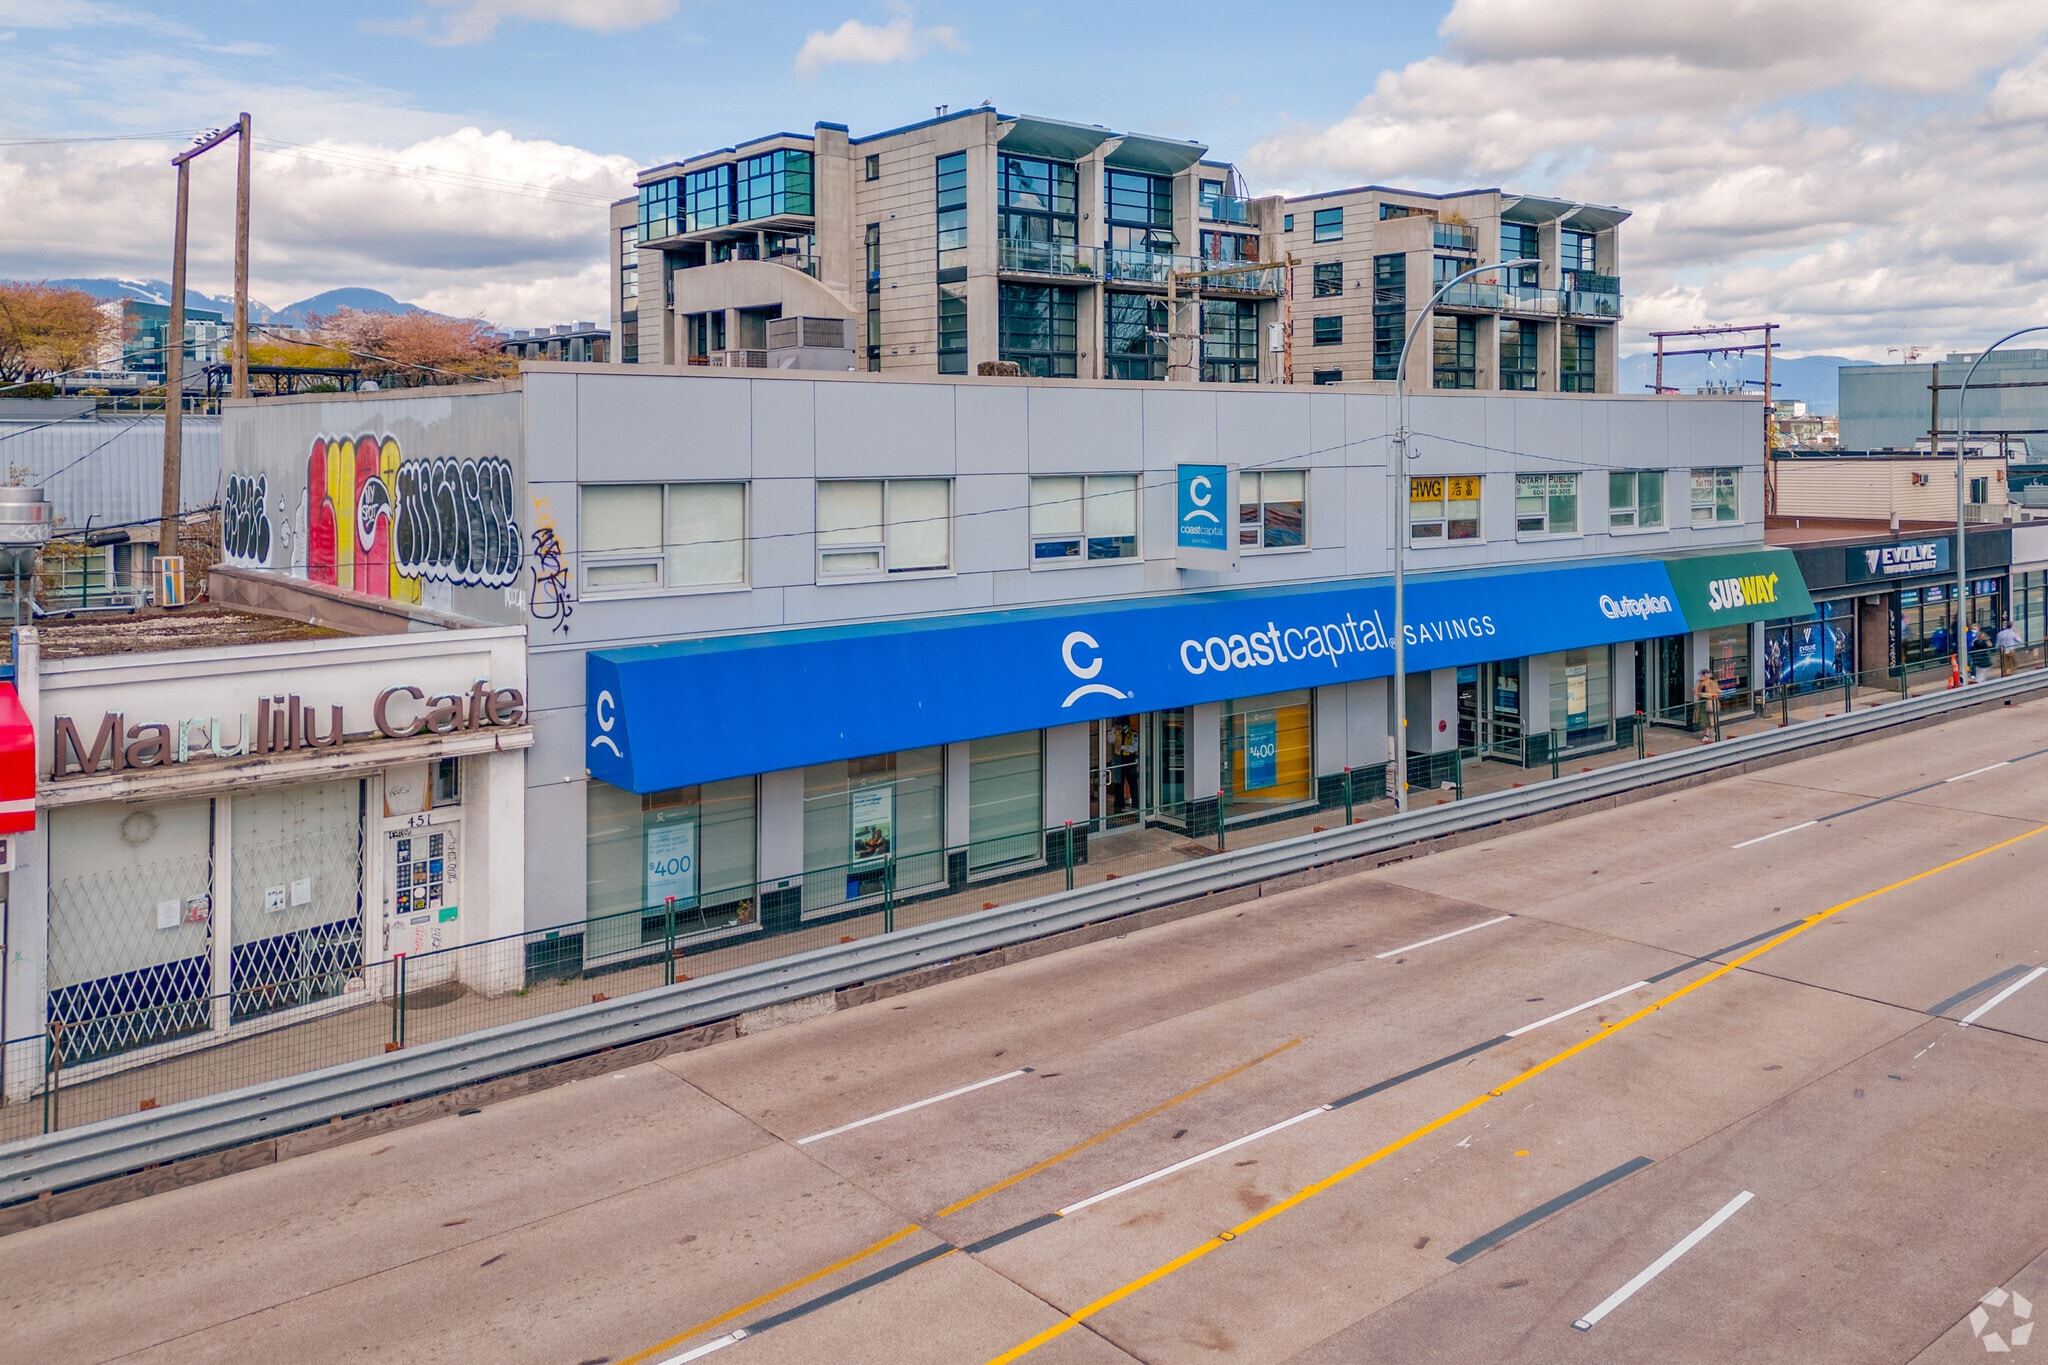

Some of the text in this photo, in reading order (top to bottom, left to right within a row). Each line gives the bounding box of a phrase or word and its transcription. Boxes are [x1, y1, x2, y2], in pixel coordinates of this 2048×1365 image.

[1411, 479, 1441, 498] HWG
[1516, 475, 1574, 484] NOTARY PUBLIC
[1882, 543, 1937, 564] EVOLVE
[1708, 572, 1779, 612] SUBWAY
[1403, 615, 1496, 646] SAVINGS
[54, 676, 524, 778] Marulilu Cafe
[1249, 743, 1275, 758] $400
[408, 813, 432, 828] 451
[649, 855, 691, 876] $400
